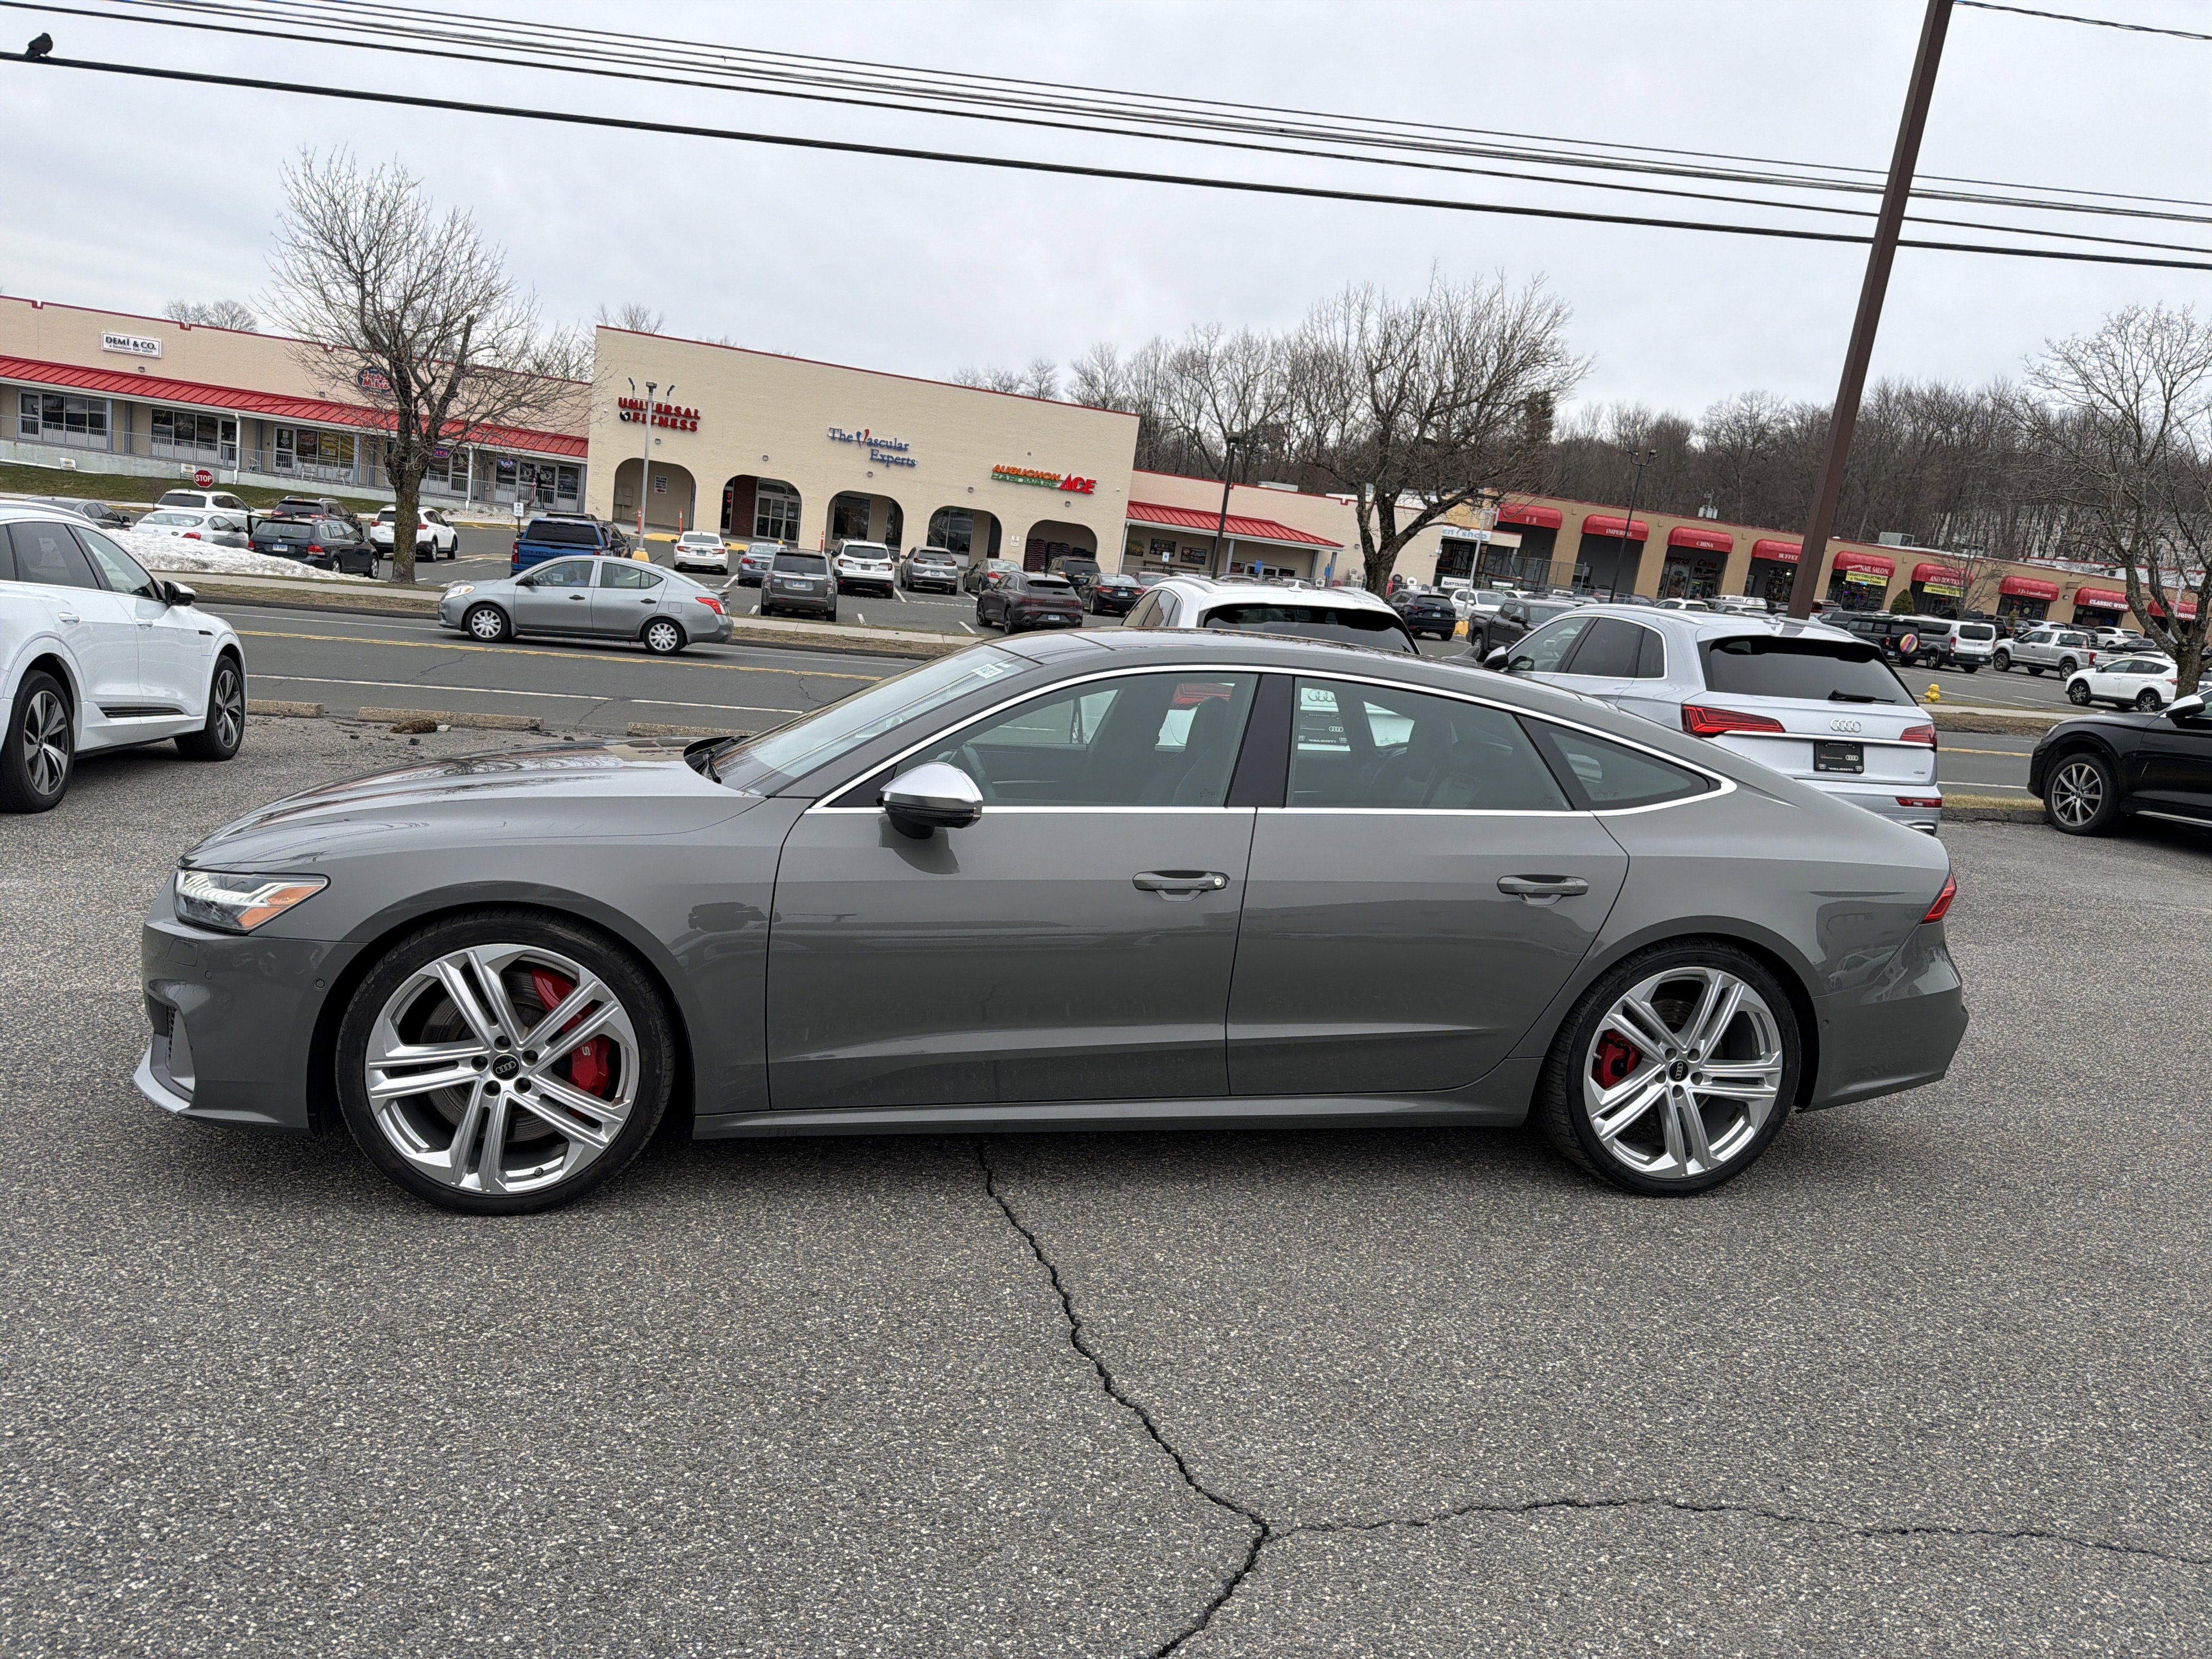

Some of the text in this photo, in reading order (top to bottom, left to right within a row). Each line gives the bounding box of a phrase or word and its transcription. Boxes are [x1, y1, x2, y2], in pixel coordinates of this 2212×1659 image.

[140, 341, 156, 350] CO.
[360, 370, 388, 382] Jerse
[618, 397, 701, 420] UNIVERSAL
[632, 412, 698, 432] FITNESS
[828, 427, 910, 452] The Vascular
[869, 448, 917, 467] Experts
[195, 475, 212, 483] STOP
[992, 464, 1098, 494] AUBUCHON ACE
[1942, 577, 1964, 586] BOUTIQ
[2089, 599, 2113, 607] CLASSIC
[2175, 612, 2196, 620] LIQUOR
